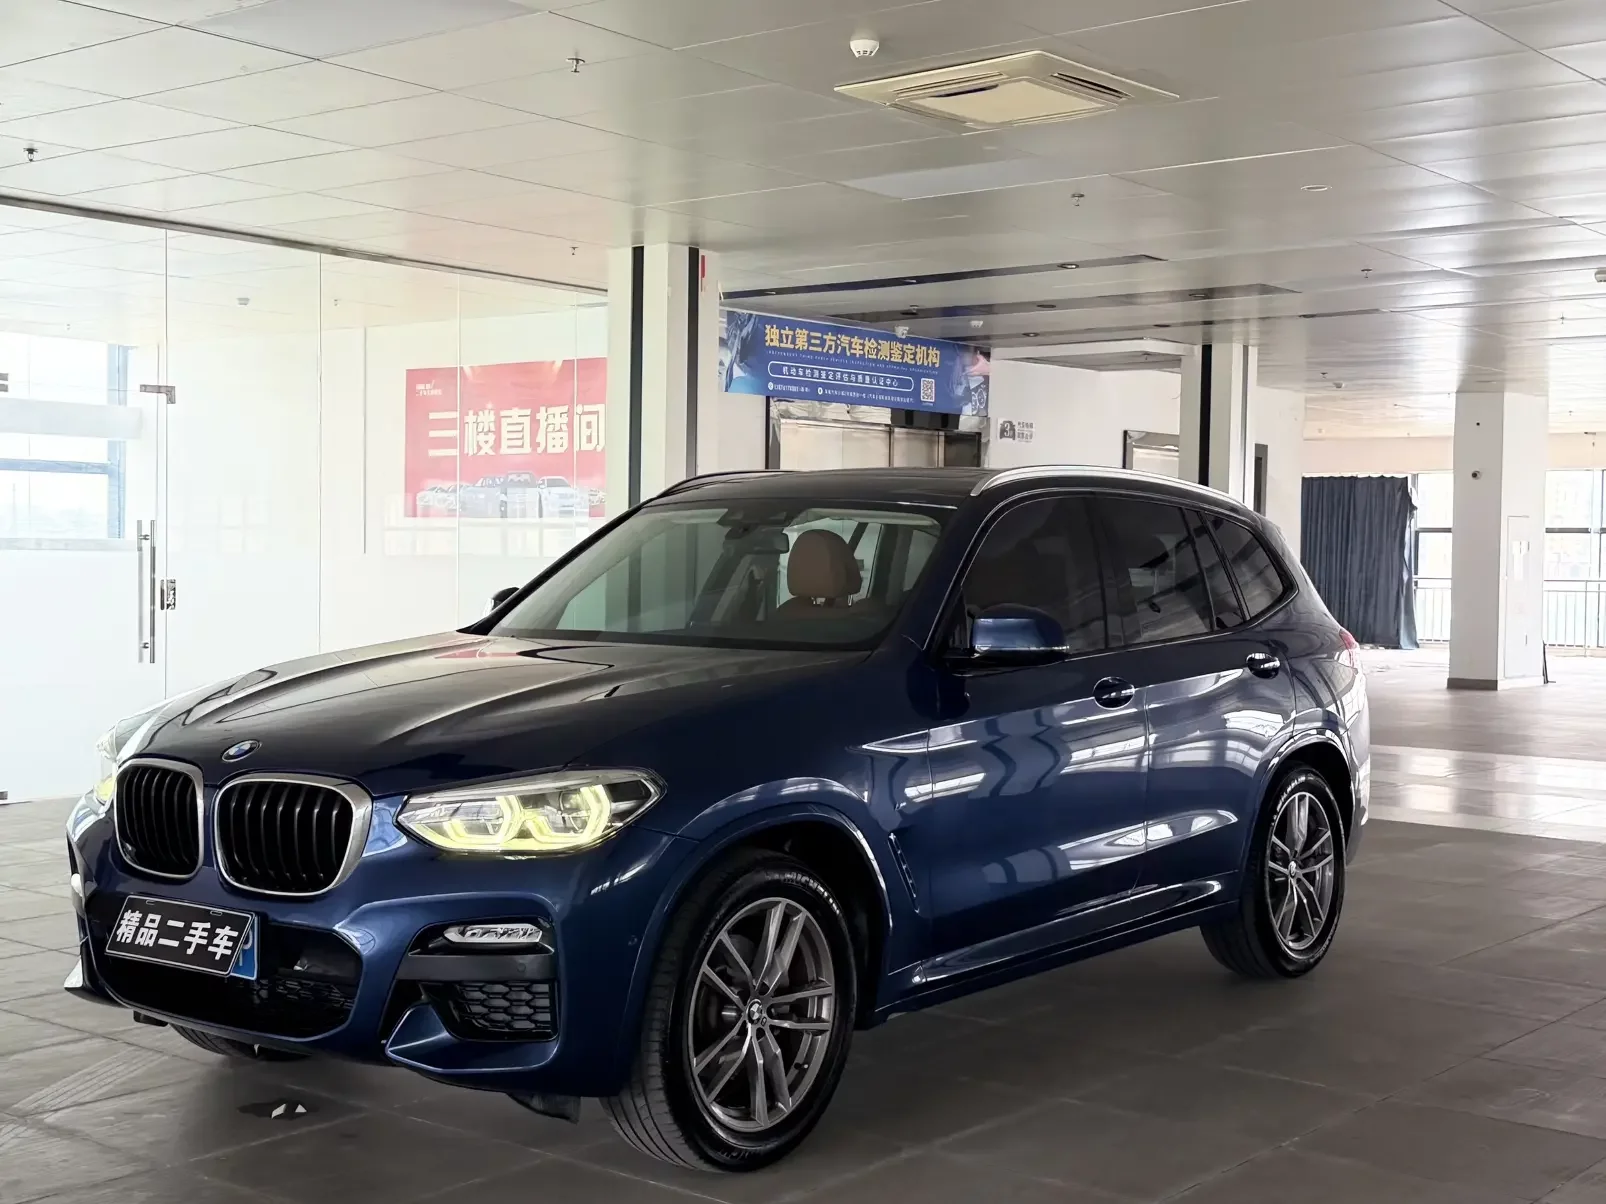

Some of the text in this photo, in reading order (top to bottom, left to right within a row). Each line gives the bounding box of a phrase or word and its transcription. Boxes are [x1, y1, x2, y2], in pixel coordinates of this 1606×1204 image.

[765, 324, 940, 368] 独立第三方汽车检测鉴定机构
[428, 404, 606, 457] 三楼直播间
[116, 910, 239, 961] 精品二手车
